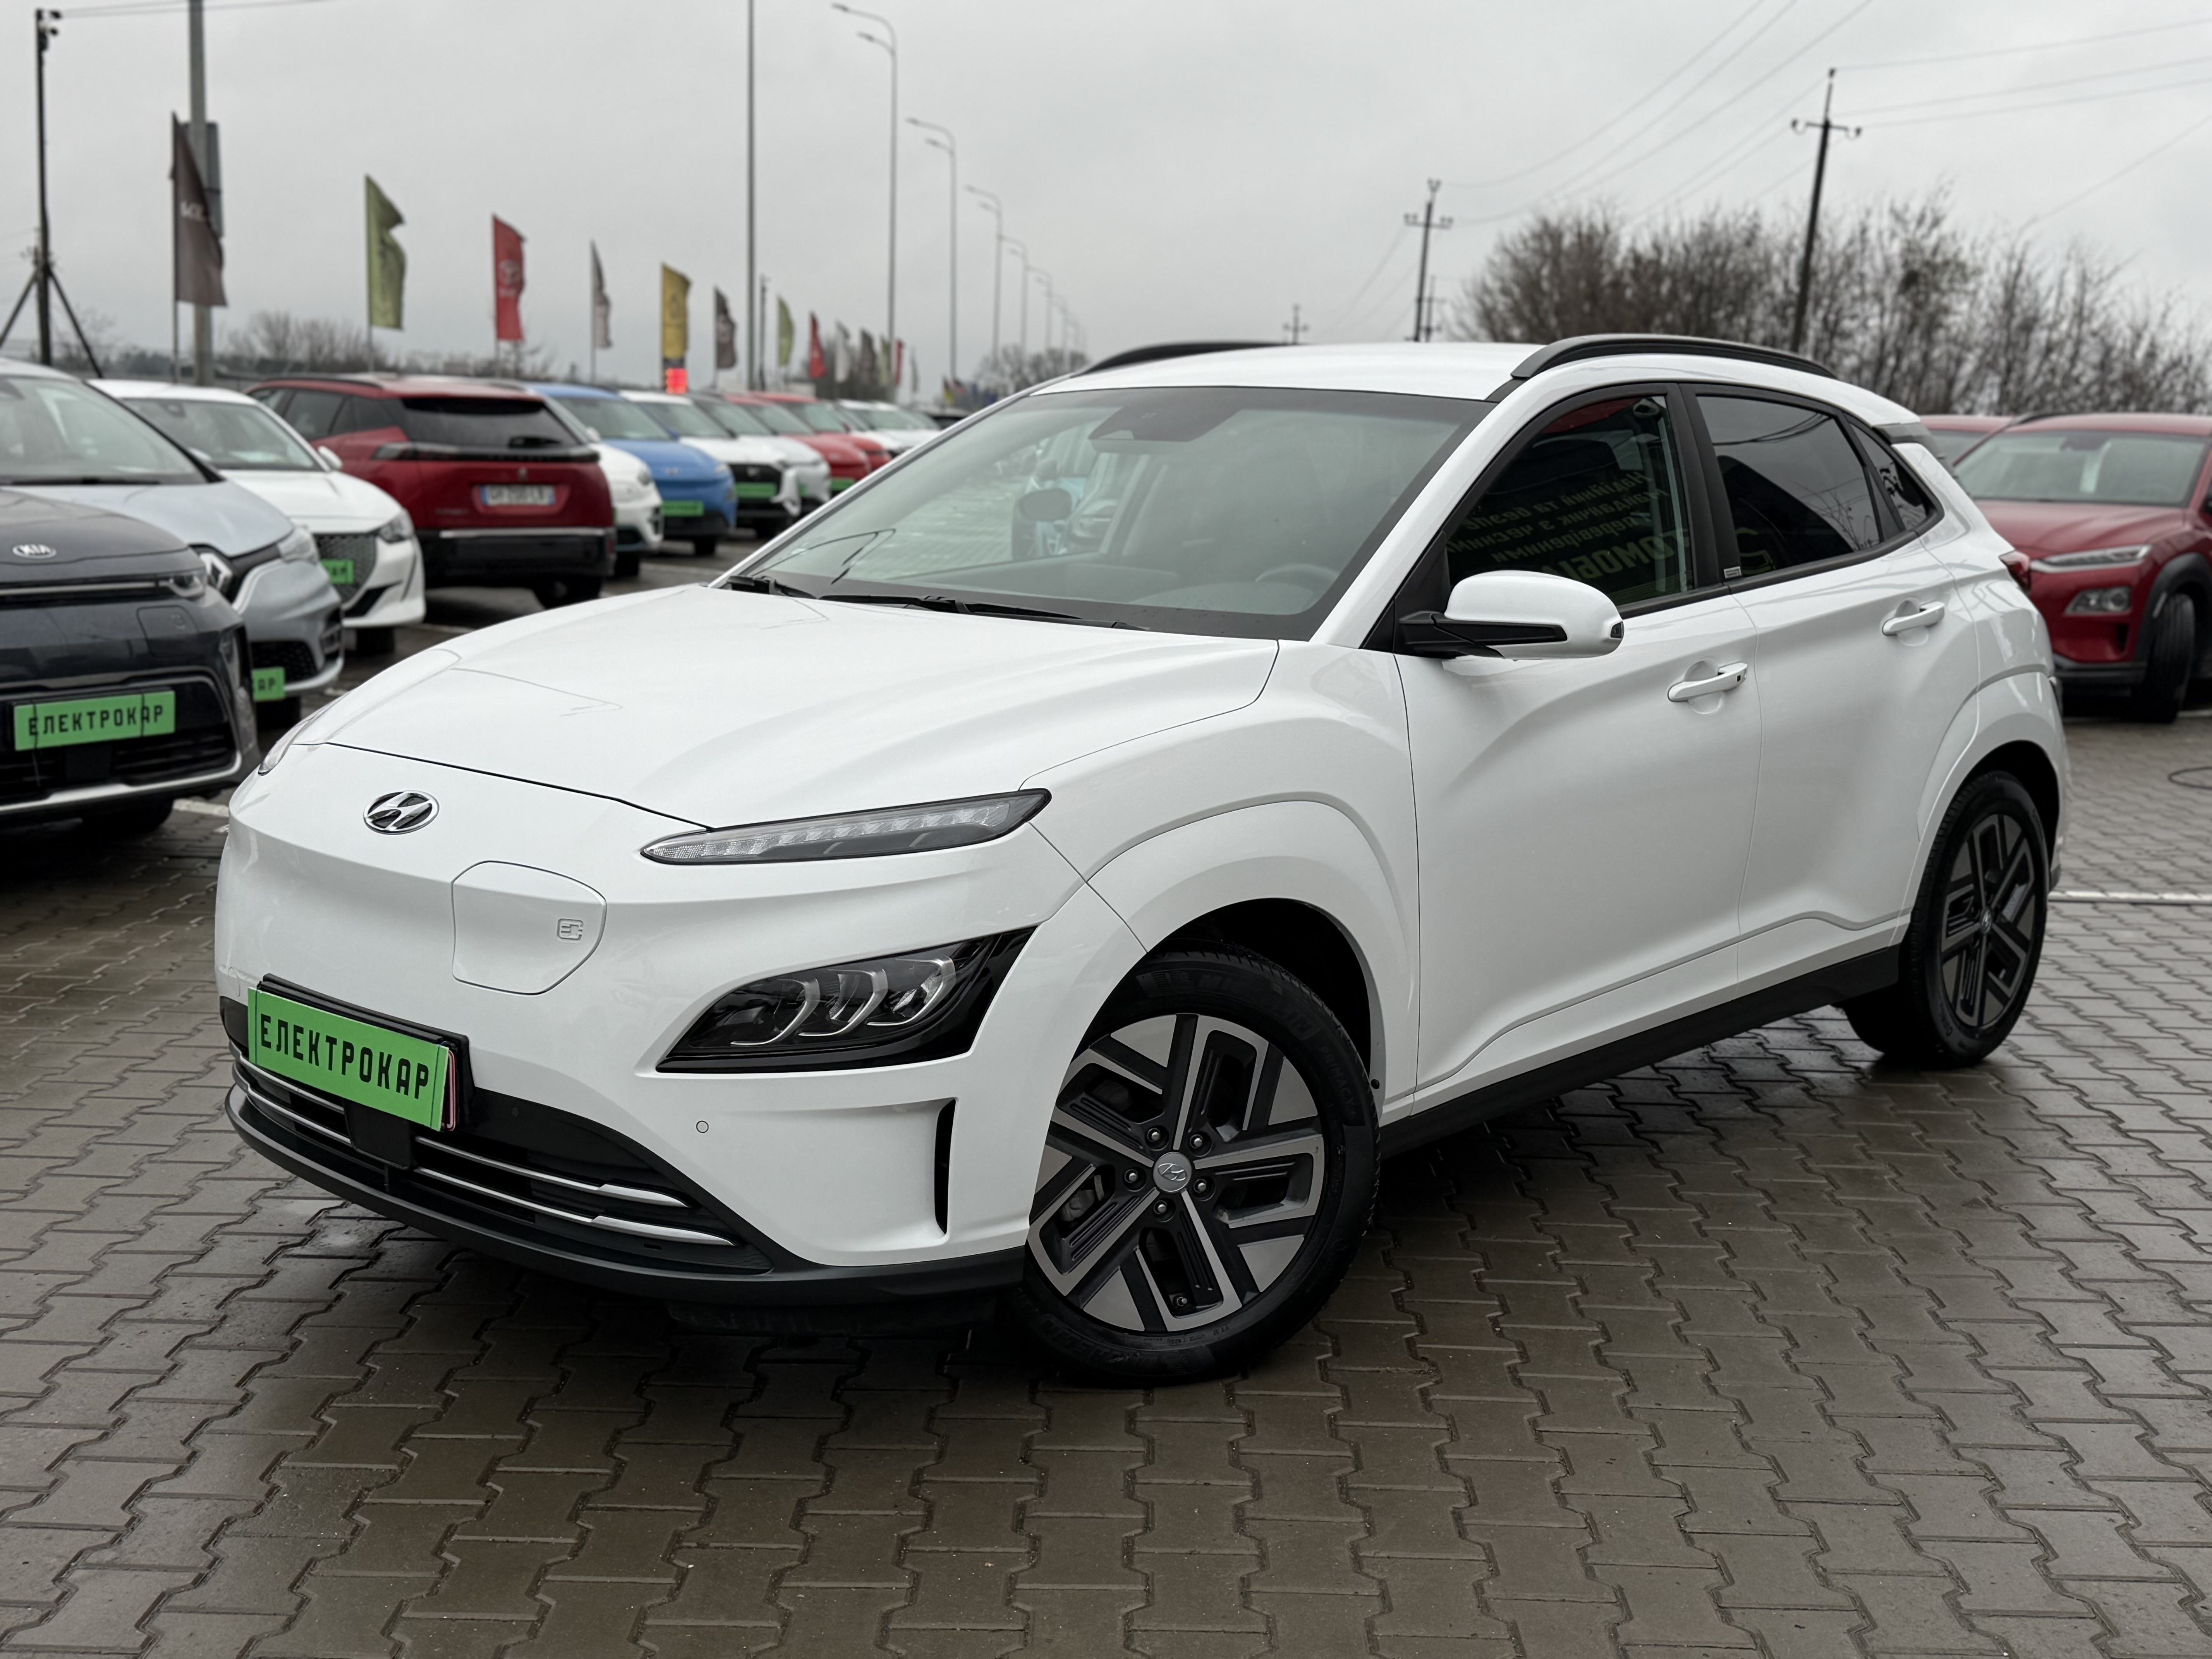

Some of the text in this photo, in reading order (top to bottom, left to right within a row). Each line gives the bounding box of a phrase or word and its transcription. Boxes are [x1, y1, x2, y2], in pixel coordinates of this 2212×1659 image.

[252, 677, 276, 692] АР
[28, 704, 164, 737] ЕЛЕКТРОКАР
[260, 1013, 429, 1100] ЕЛЕКТРОКАР
